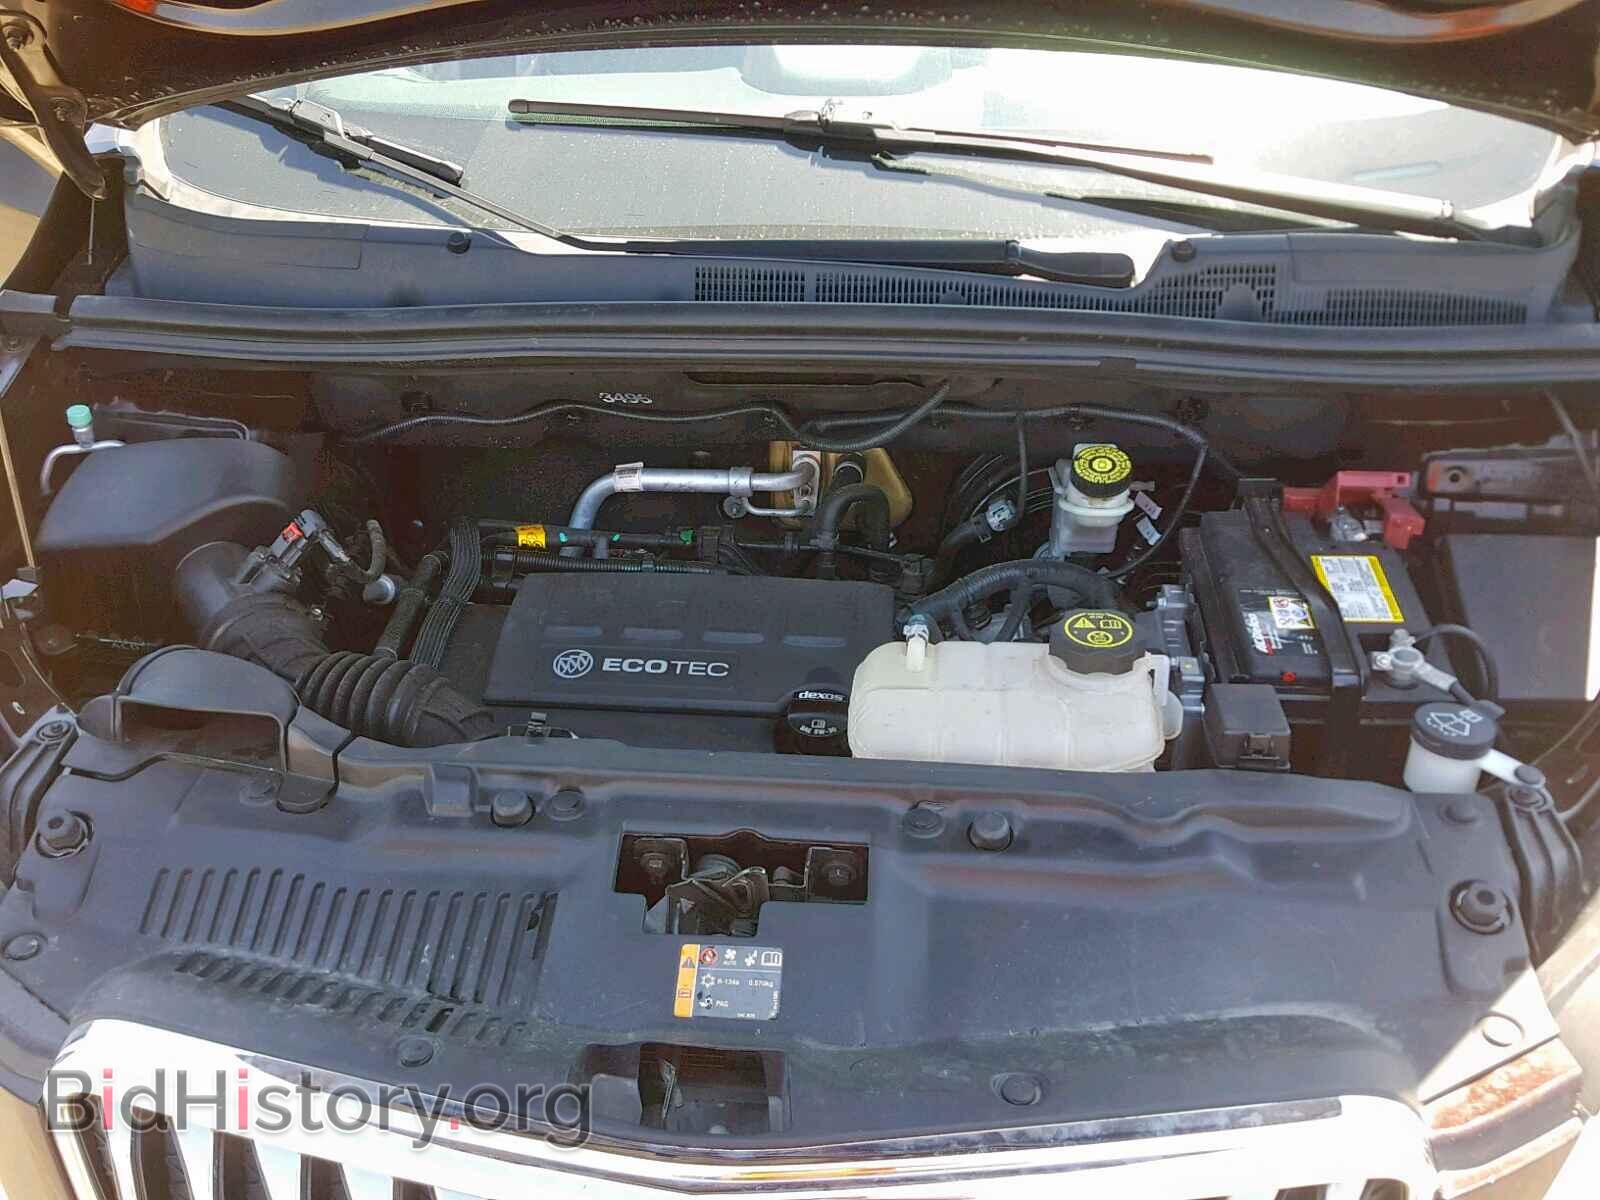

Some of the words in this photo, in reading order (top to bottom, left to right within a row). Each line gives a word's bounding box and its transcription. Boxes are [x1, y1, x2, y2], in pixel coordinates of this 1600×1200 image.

[599, 392, 653, 404] 3495
[602, 658, 730, 677] ECOTEC
[798, 690, 844, 701] dexos
